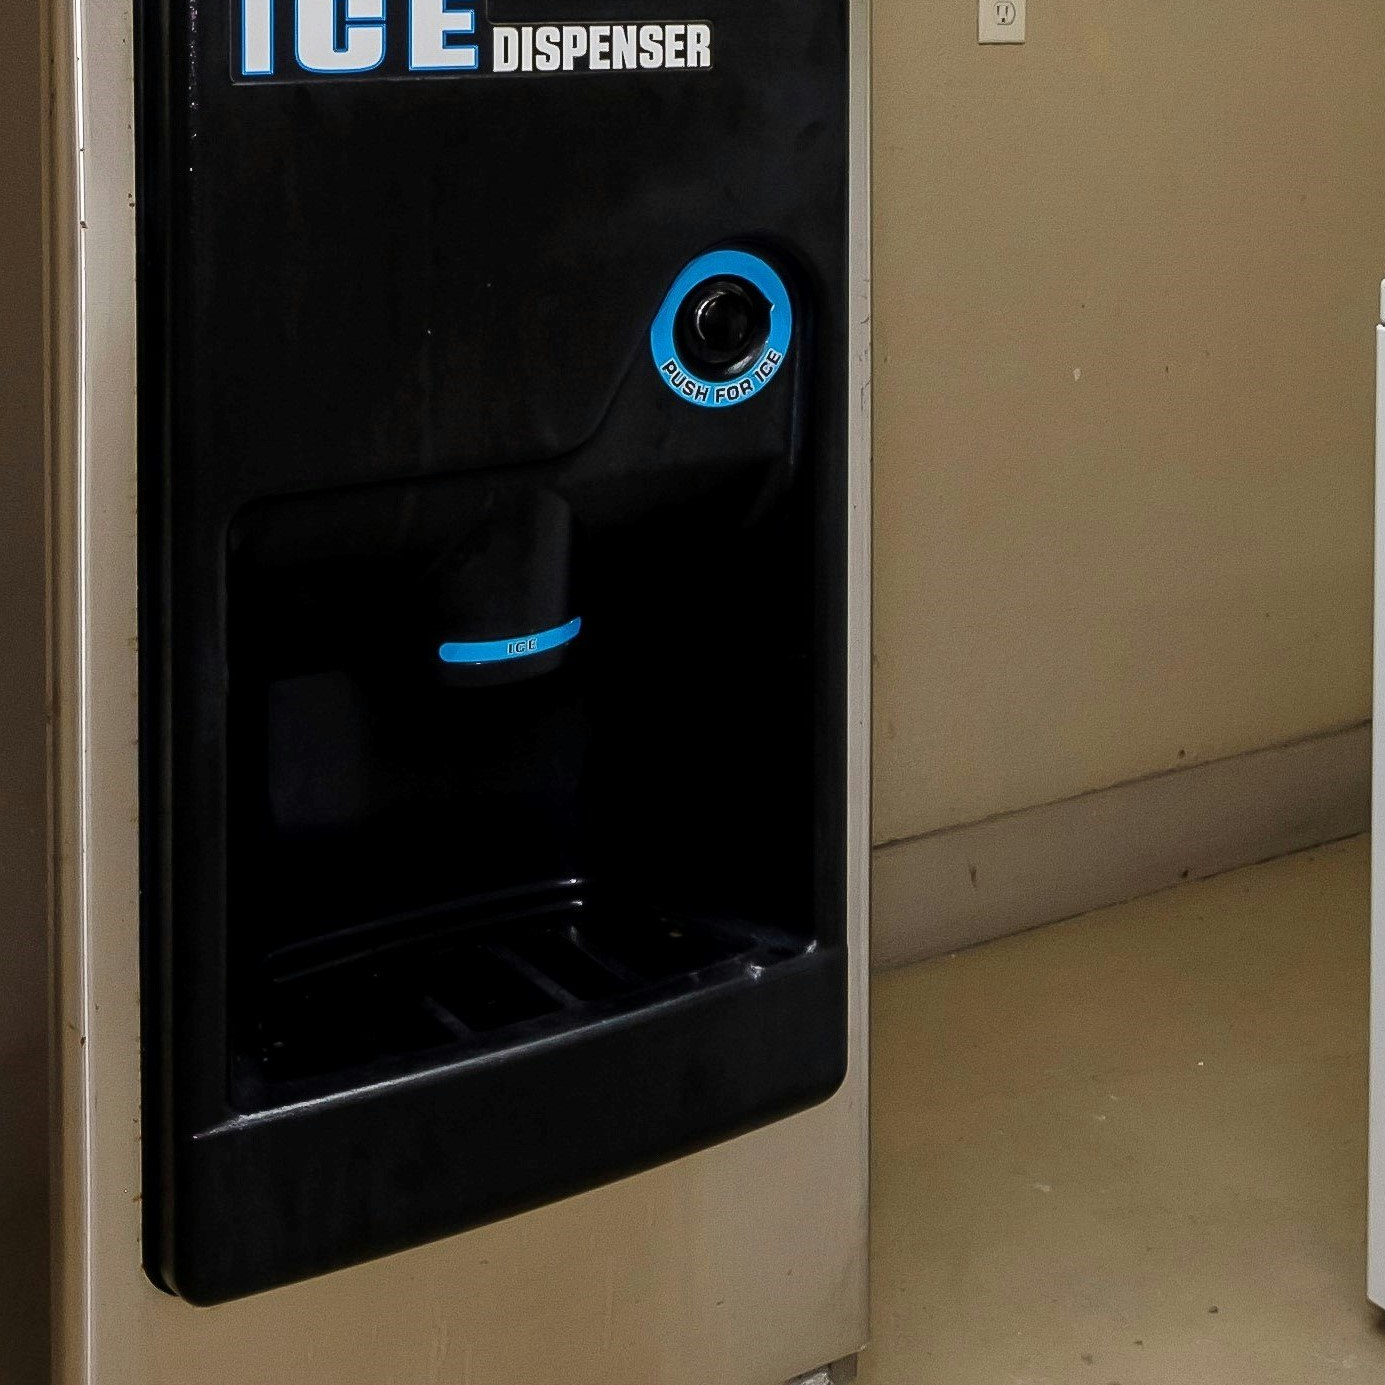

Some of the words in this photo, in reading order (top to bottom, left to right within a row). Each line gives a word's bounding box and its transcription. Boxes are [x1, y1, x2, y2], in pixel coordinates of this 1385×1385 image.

[492, 23, 712, 73] DISPENSER
[660, 358, 711, 402] PUSH
[714, 379, 755, 404] FOR
[753, 348, 783, 383] ICE
[507, 638, 538, 655] ICE
